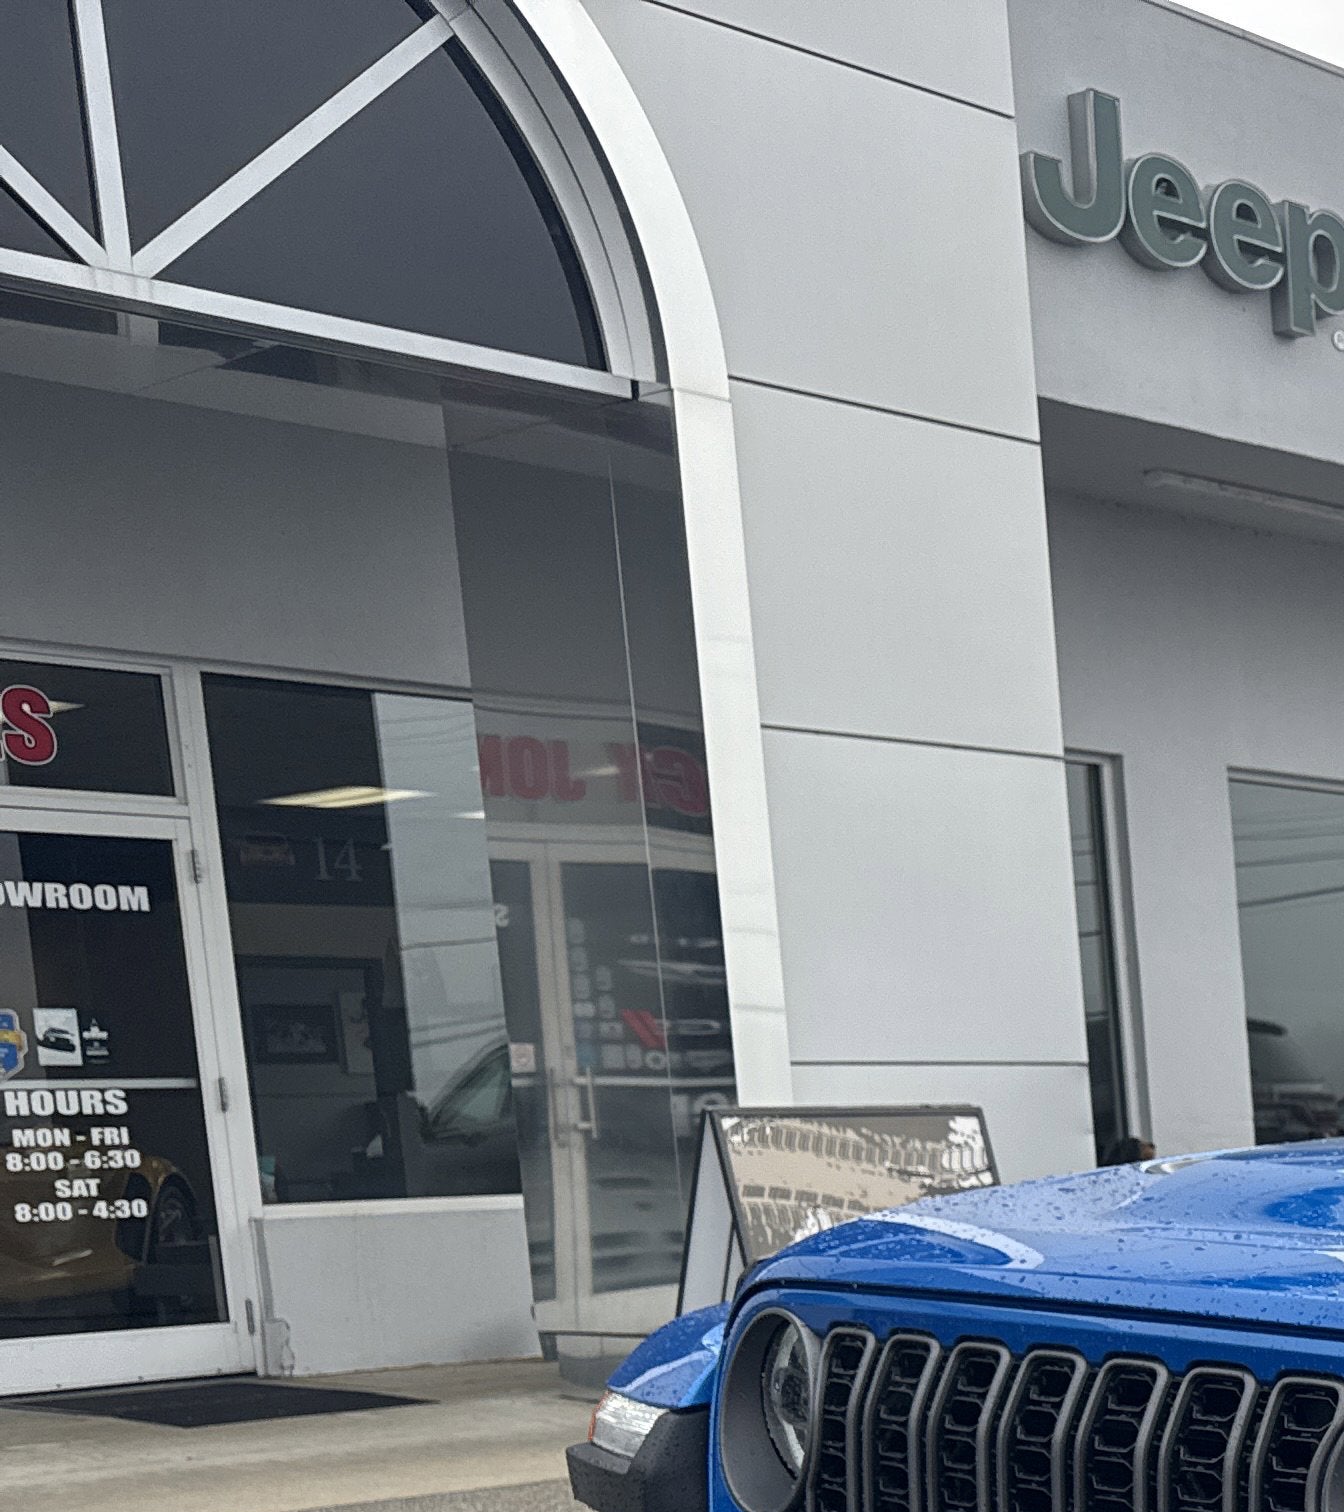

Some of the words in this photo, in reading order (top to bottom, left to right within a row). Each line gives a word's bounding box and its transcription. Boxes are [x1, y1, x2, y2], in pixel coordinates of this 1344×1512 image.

[0, 684, 58, 765] S
[0, 881, 151, 913] WROOM
[3, 1089, 129, 1117] HOURS
[11, 1127, 72, 1148] MON
[90, 1126, 131, 1147] FRI
[5, 1152, 65, 1173] 8:00
[83, 1149, 142, 1170] 6:30
[54, 1178, 101, 1199] SAT
[14, 1201, 73, 1223] 8:00
[92, 1198, 149, 1220] 4:30
